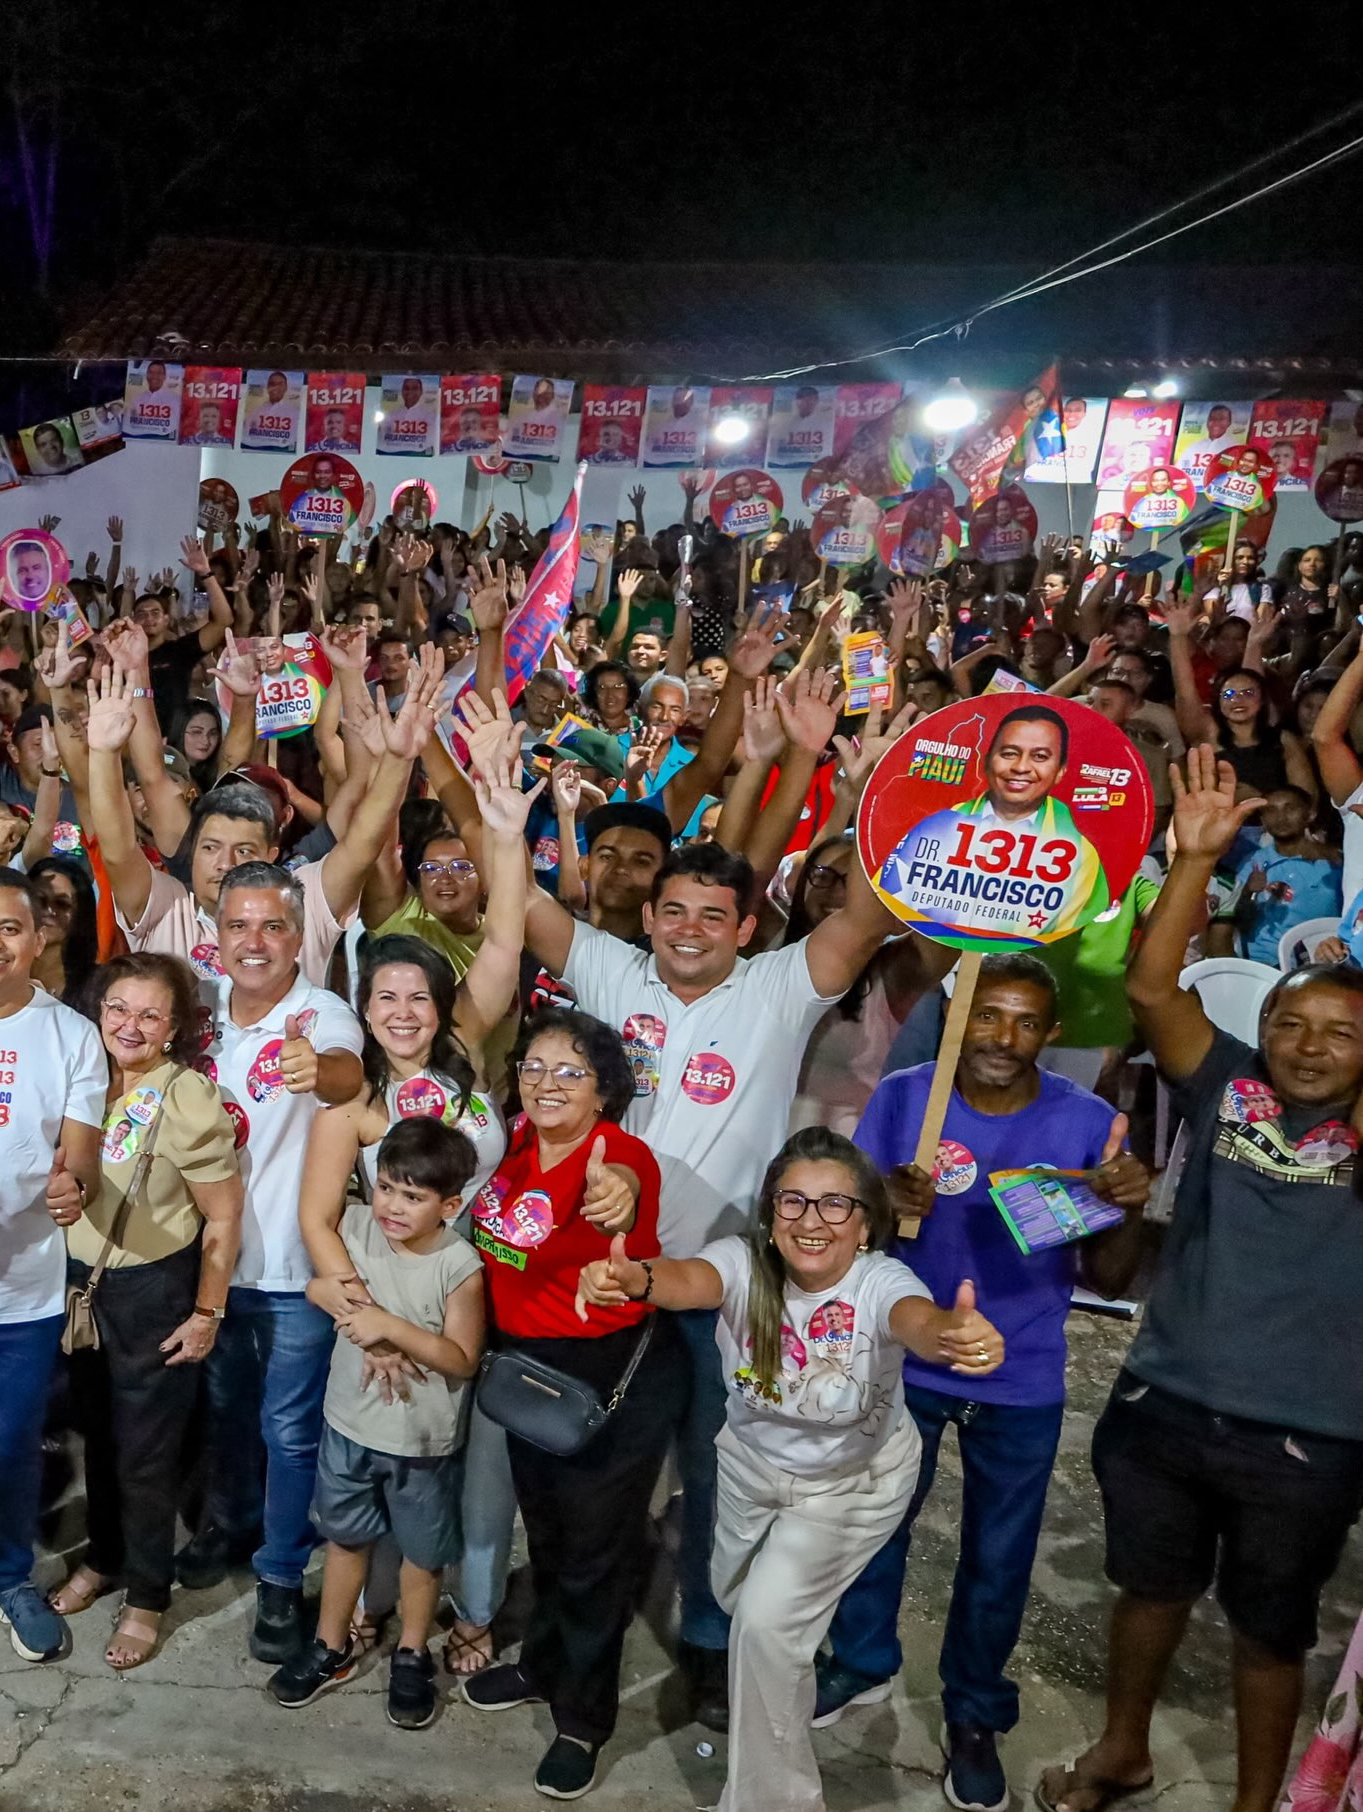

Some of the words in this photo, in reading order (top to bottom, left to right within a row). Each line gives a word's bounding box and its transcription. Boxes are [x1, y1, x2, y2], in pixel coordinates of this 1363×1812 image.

[186, 383, 238, 399] 13.121
[310, 388, 362, 405] 13.121
[444, 386, 498, 405] 13.121
[139, 404, 171, 418] 1313
[585, 400, 641, 416] 13.121
[130, 417, 170, 427] FRANCISCO
[259, 416, 291, 430] 1313
[394, 420, 428, 434] 1313
[1253, 418, 1319, 438] 13.121
[249, 428, 290, 439] FRANCISCO
[522, 423, 557, 438] 1313
[662, 431, 696, 445] 1313
[789, 431, 823, 445] 1313
[1212, 485, 1252, 503] FRANCISCO
[1224, 477, 1257, 496] 1313
[306, 496, 345, 514] 1313
[735, 502, 768, 518] 1313
[1146, 499, 1177, 512] 1313
[296, 511, 344, 524] FRANCISCO
[728, 514, 770, 528] FRANCISCO
[1136, 510, 1177, 519] FRANCISCO
[834, 532, 867, 545] 1313
[259, 678, 309, 705] 1313
[256, 698, 311, 719] RANCISCO
[915, 738, 958, 758] ORGULHO
[958, 746, 972, 760] DO
[1079, 763, 1111, 778] RAFAEL
[1109, 768, 1132, 787] 13
[1072, 794, 1108, 802] LULA
[914, 836, 940, 863] DR.
[946, 822, 1077, 883] 1313
[907, 861, 1064, 911] FRANCISCO
[911, 891, 969, 913] DEPUTADO
[975, 904, 1021, 922] FEDERAL
[0, 1050, 17, 1064] 13
[258, 1057, 280, 1074] 13.1
[685, 1068, 731, 1090] 13.121
[135, 1104, 152, 1118] 1313
[399, 1094, 442, 1112] 13.121
[474, 1113, 488, 1128] 13
[110, 1146, 125, 1160] 13
[943, 1172, 970, 1192] 13121
[480, 1182, 501, 1215] 3.121
[513, 1203, 543, 1242] 13.121
